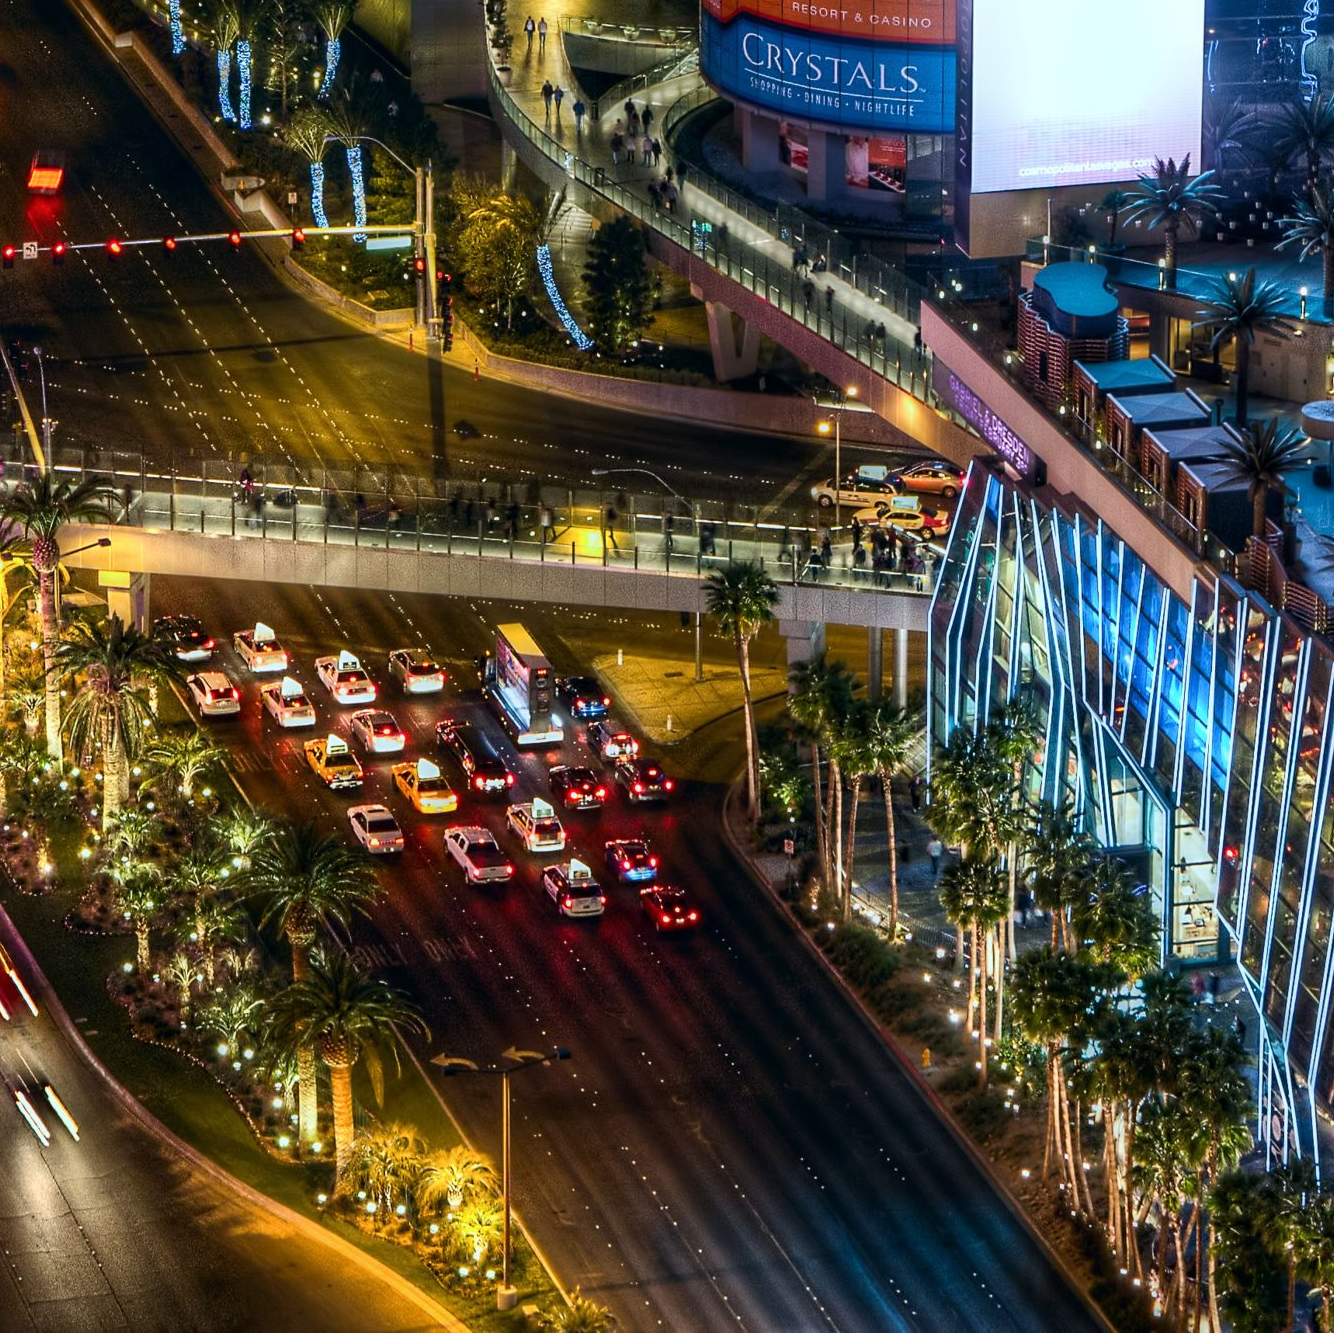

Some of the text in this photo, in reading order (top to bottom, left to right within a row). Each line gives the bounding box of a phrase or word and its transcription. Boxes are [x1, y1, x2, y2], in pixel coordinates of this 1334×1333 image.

[792, 2, 932, 28] RESORT & CASINO
[742, 32, 919, 93] CRYSTALS
[750, 76, 916, 117] SHOPPING DINING NIGHTLIFE
